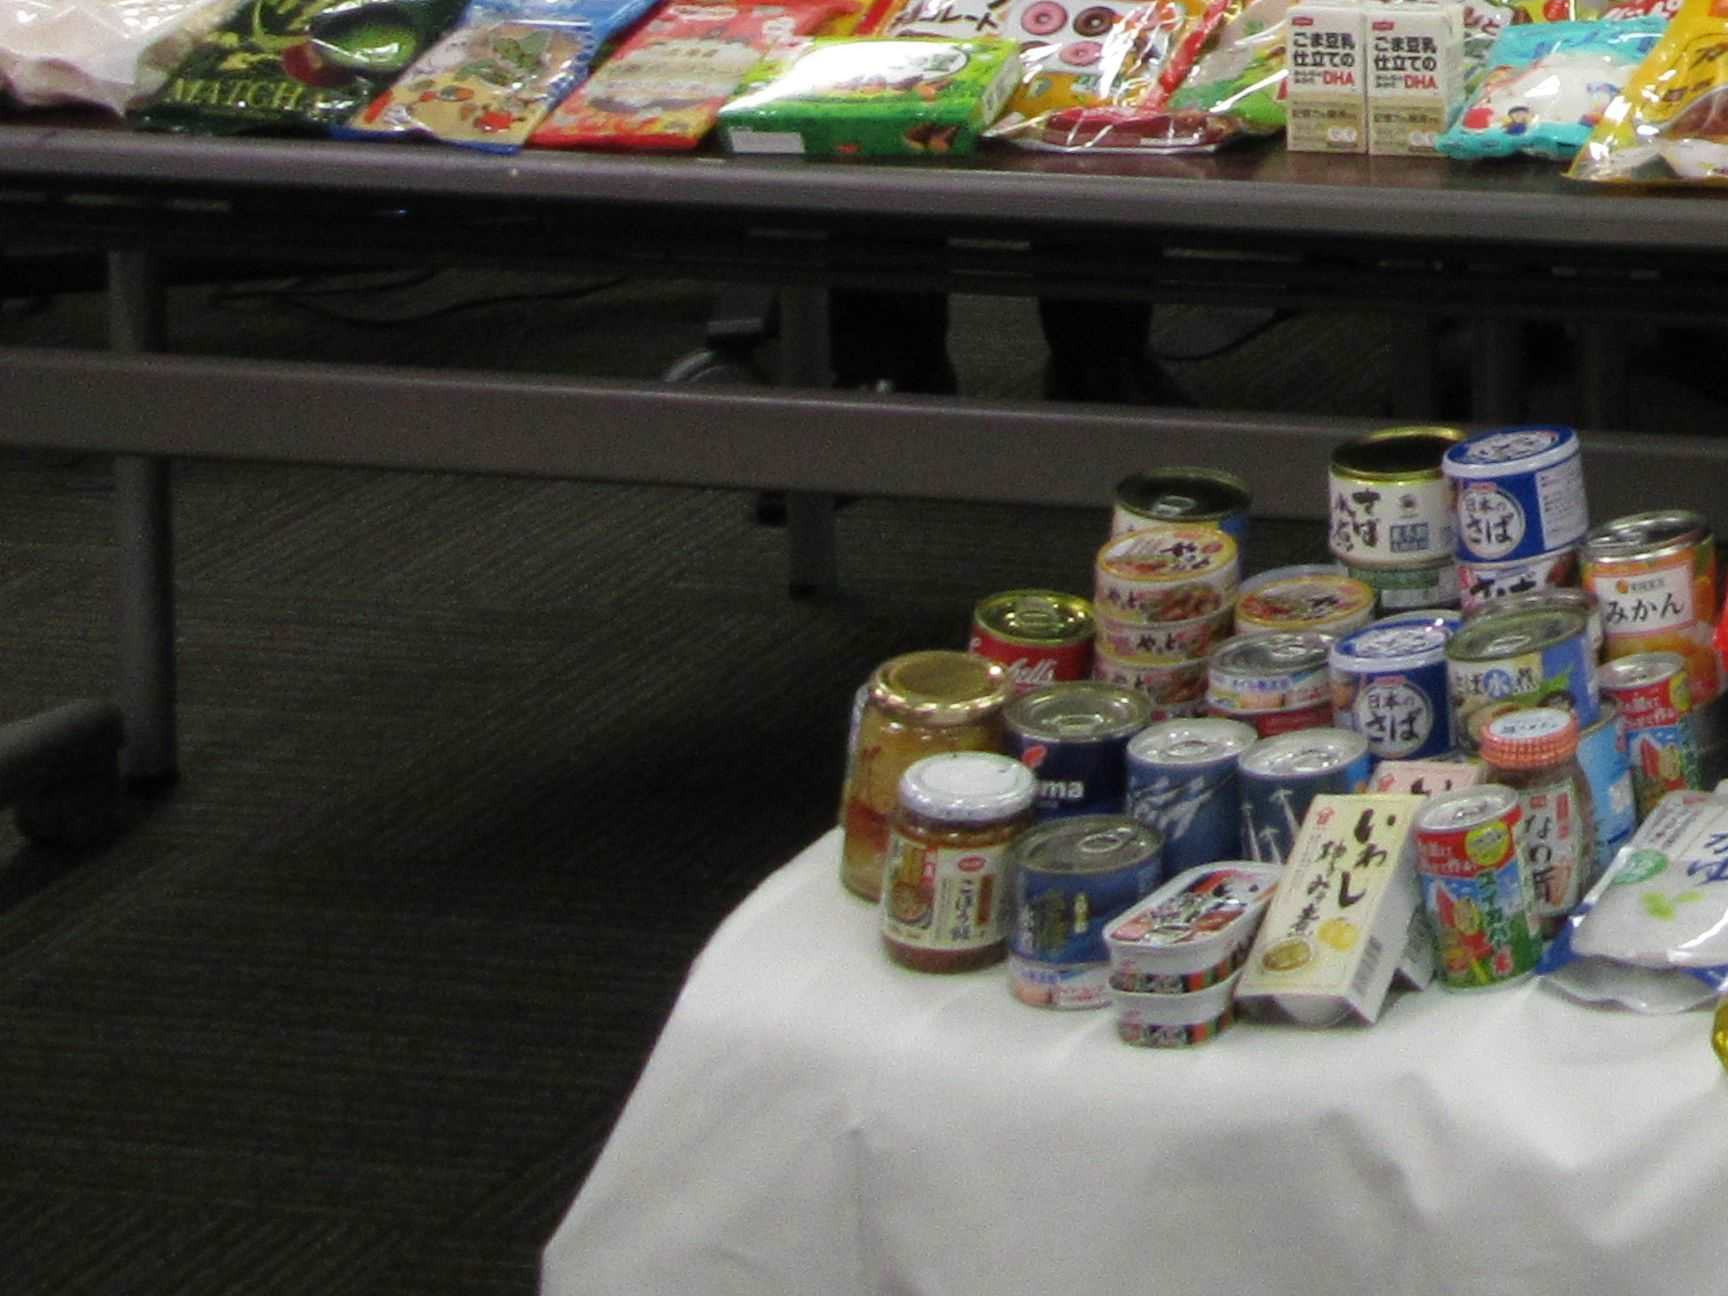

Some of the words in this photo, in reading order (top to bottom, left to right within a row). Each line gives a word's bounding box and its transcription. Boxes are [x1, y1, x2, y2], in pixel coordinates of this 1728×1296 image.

[1292, 32, 1356, 50] ごま豆乳
[1374, 36, 1438, 54] ごま豆乳
[1292, 50, 1356, 68] 仕立ての
[1374, 55, 1438, 72] 仕立ての
[1322, 71, 1356, 87] DHA
[1404, 74, 1439, 90] DHA
[1465, 512, 1515, 546] さば
[1604, 592, 1683, 625] みかん
[1364, 712, 1421, 744] さば
[1336, 806, 1399, 909] いわし
